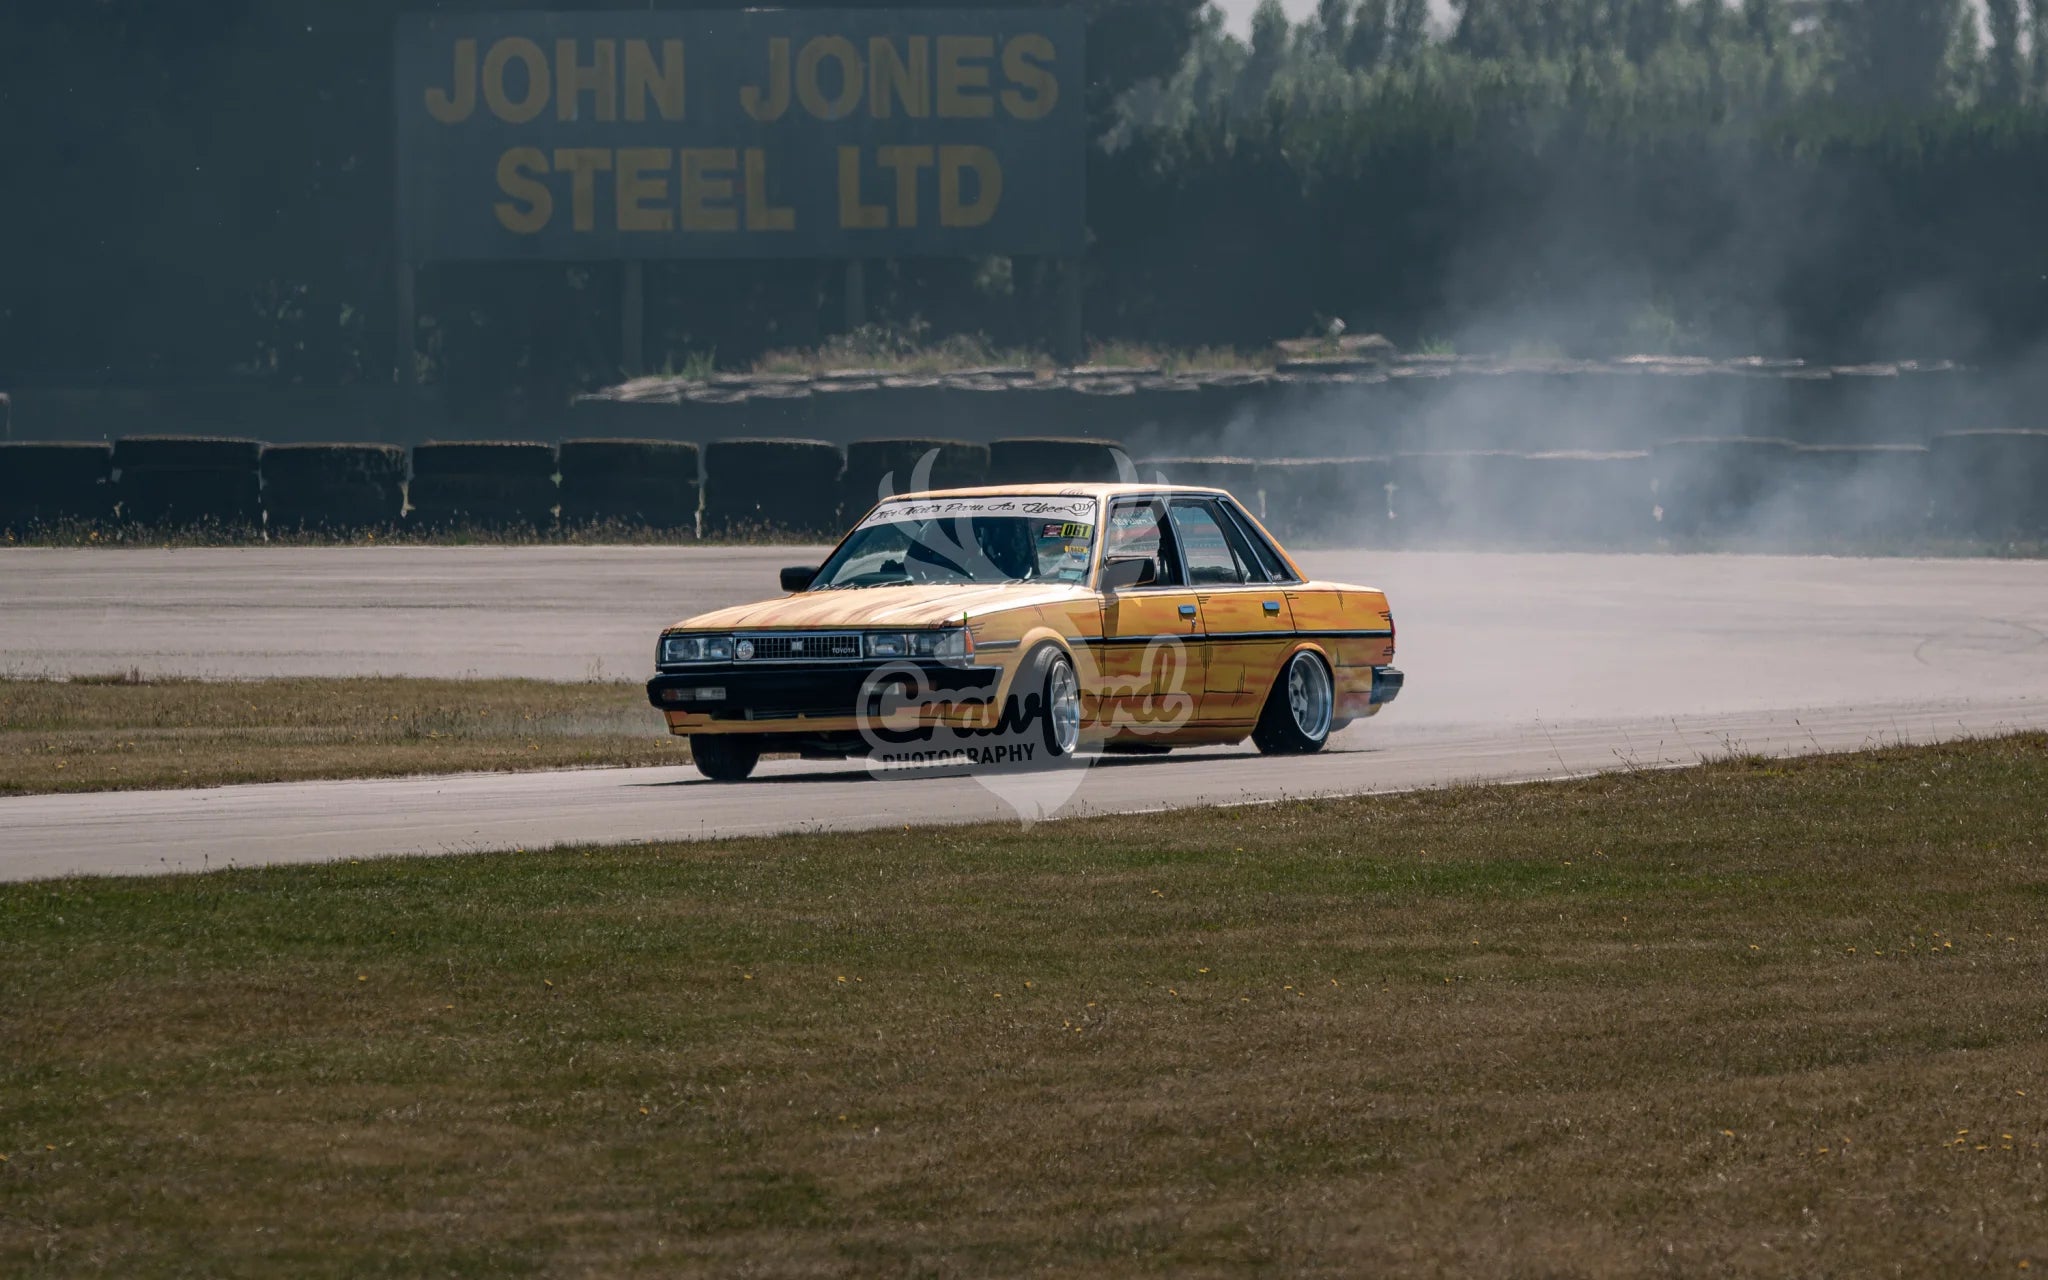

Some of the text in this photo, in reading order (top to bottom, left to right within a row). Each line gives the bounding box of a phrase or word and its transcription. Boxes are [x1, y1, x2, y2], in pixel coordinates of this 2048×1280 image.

[424, 33, 1060, 123] JOHN JONES
[494, 144, 1003, 235] STEEL LTD
